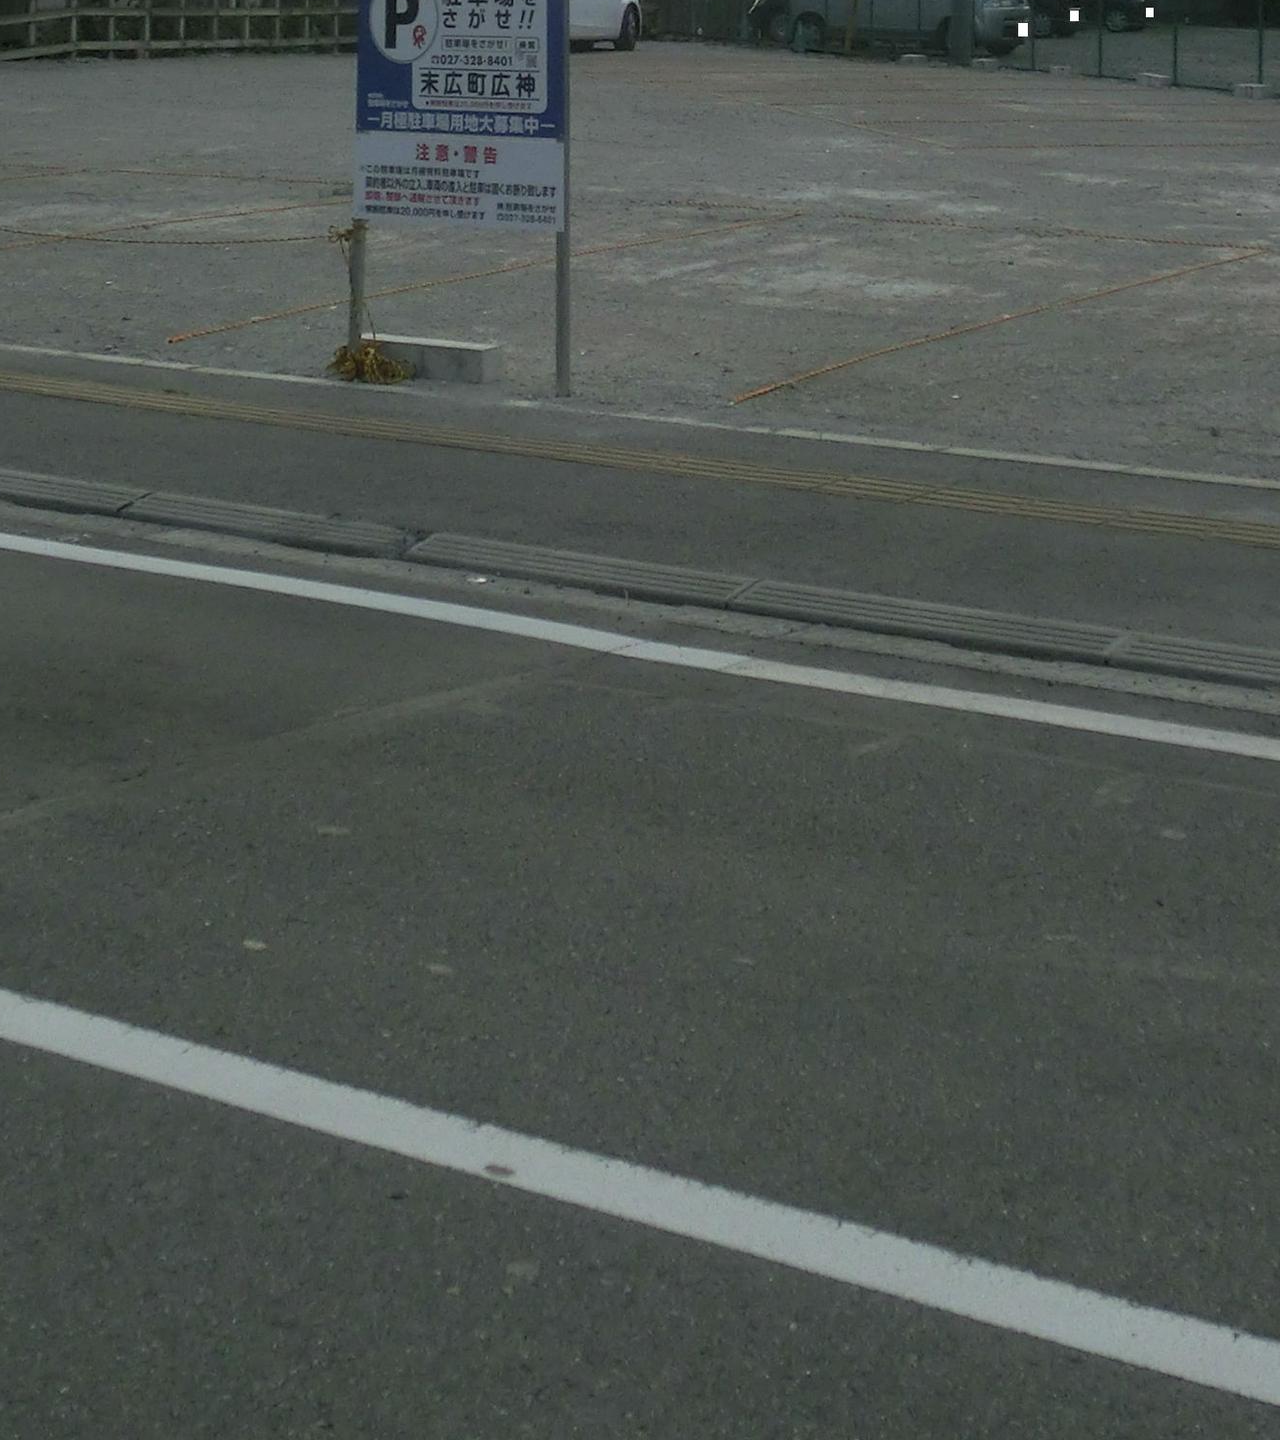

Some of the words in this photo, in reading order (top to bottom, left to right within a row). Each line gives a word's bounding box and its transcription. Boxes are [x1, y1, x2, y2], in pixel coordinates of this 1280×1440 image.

[420, 71, 536, 98] 末広町広神
